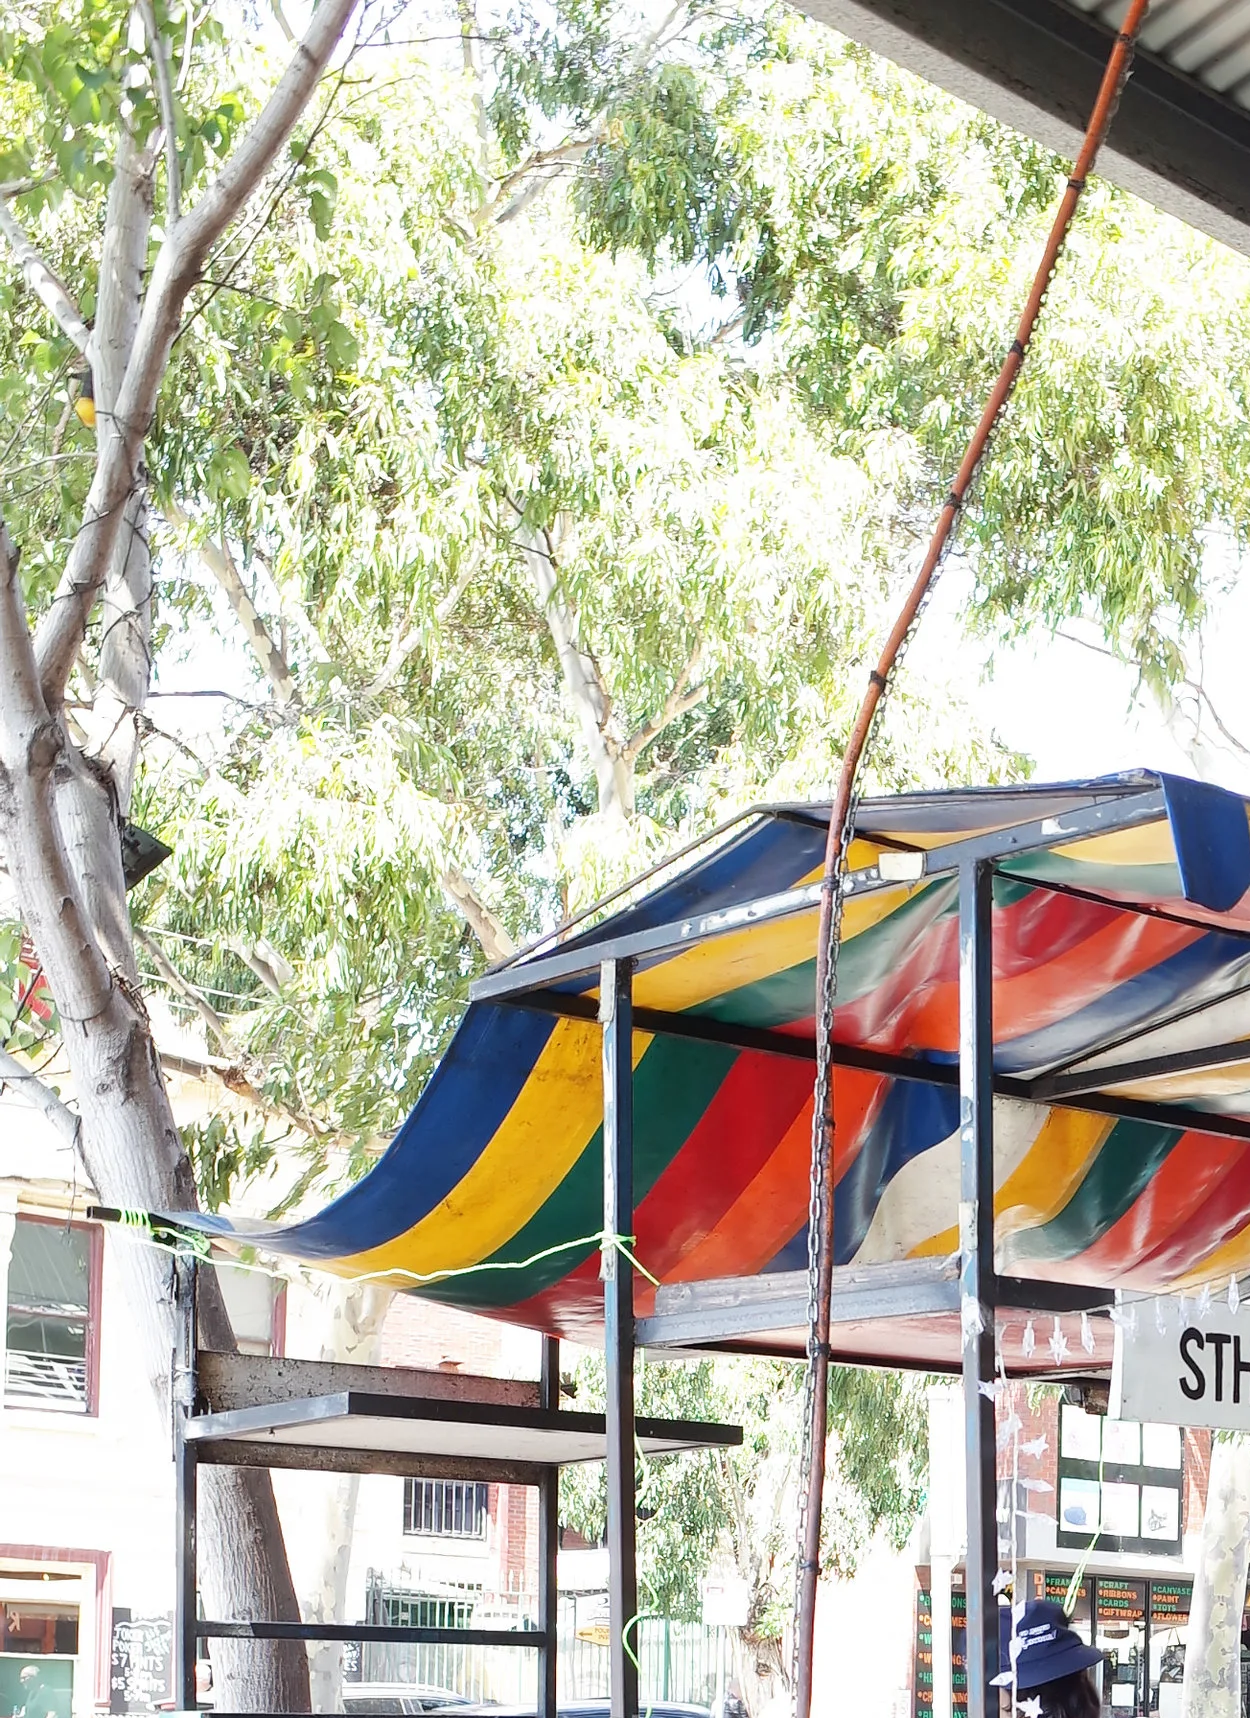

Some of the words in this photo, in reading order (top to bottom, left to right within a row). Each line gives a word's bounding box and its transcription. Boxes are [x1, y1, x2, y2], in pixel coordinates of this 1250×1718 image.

[1103, 1581, 1129, 1590] CRAFT
[1103, 1590, 1138, 1600] RIBBONS
[1103, 1599, 1129, 1608] CARDS
[1103, 1608, 1143, 1618] GIFTWRAP
